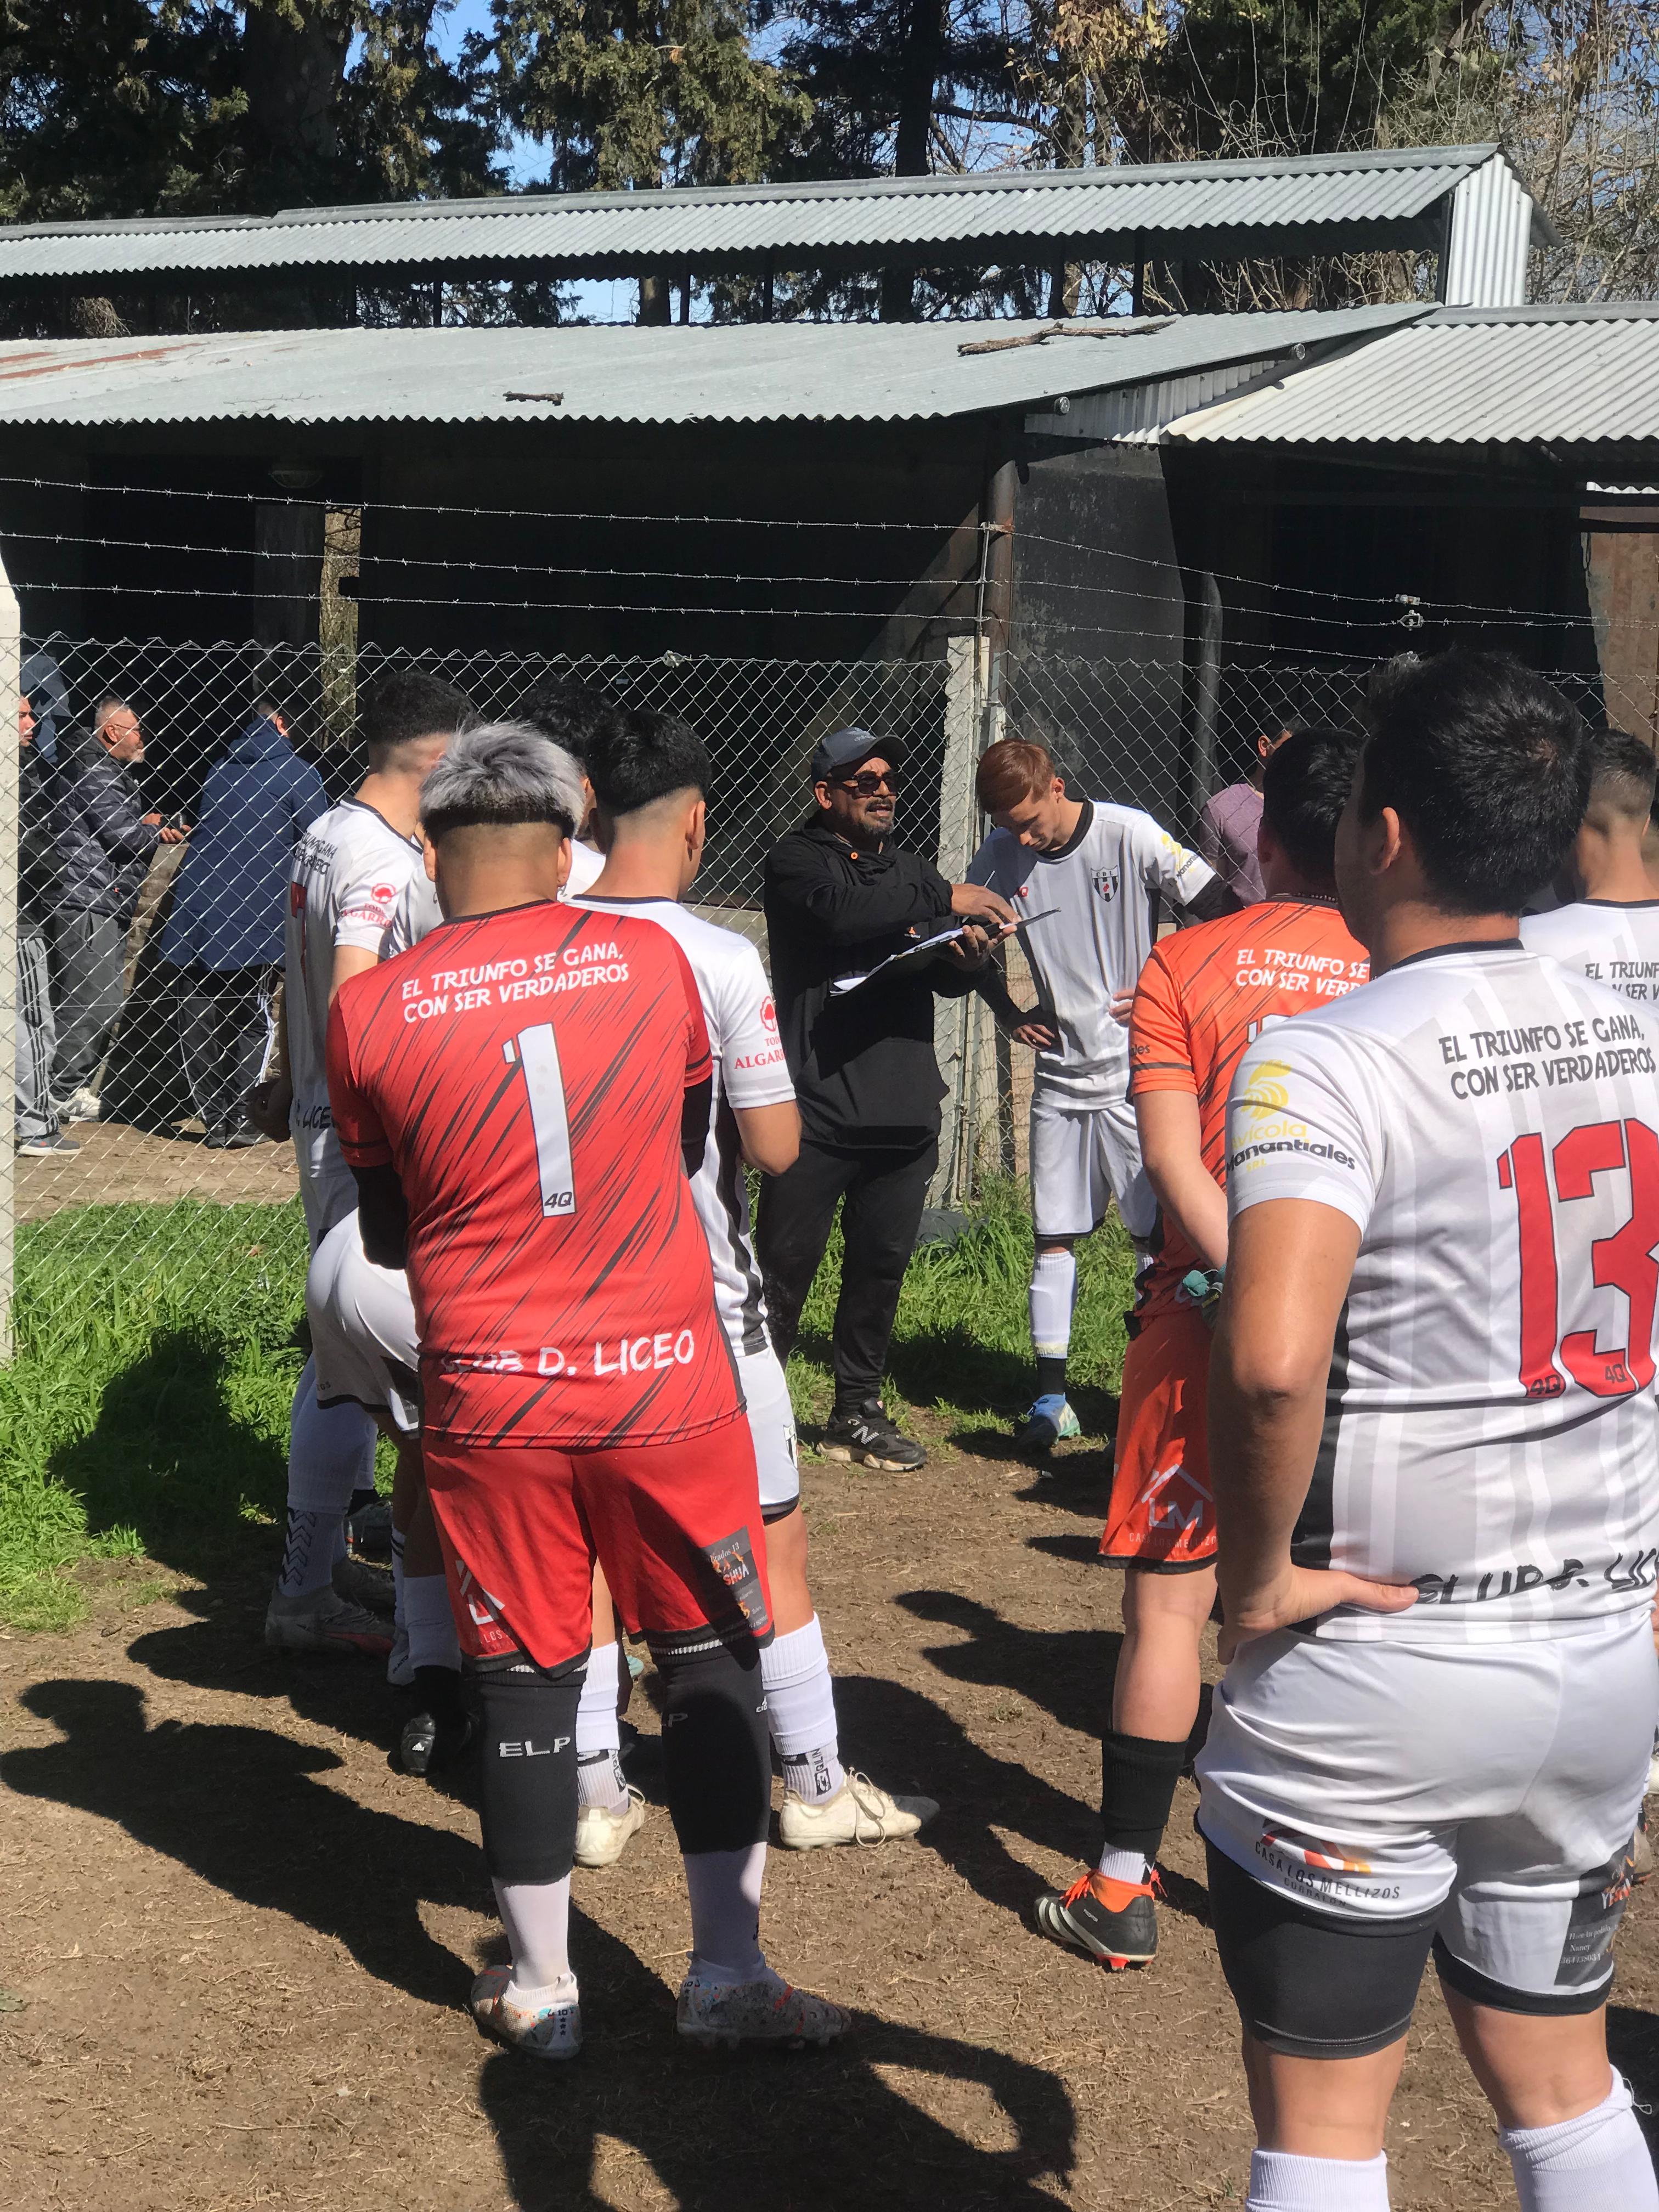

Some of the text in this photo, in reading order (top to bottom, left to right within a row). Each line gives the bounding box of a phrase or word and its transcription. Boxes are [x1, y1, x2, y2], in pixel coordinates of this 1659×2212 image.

[402, 942, 624, 1001] EL TRIUNFO SE GANA,
[1236, 969, 1276, 986] CON
[1279, 972, 1310, 992] SER
[1237, 949, 1370, 979] EL TRIUNFO SE
[1585, 961, 1659, 980] EL TRIUNF
[404, 963, 629, 1023] CON SER VERDADEROS
[1626, 983, 1647, 1001] SER
[1438, 1014, 1645, 1064] EL TRIUNFO SE GANA,
[1451, 1047, 1657, 1100] CON SER VERDADEROS
[501, 1023, 576, 1217] 1
[544, 1192, 573, 1209] 4Q
[1497, 1117, 1659, 1398] 13
[538, 1347, 578, 1376] D.
[594, 1329, 695, 1376] LICEO
[1255, 1841, 1400, 1899] CASA LOS MELLIZOS
